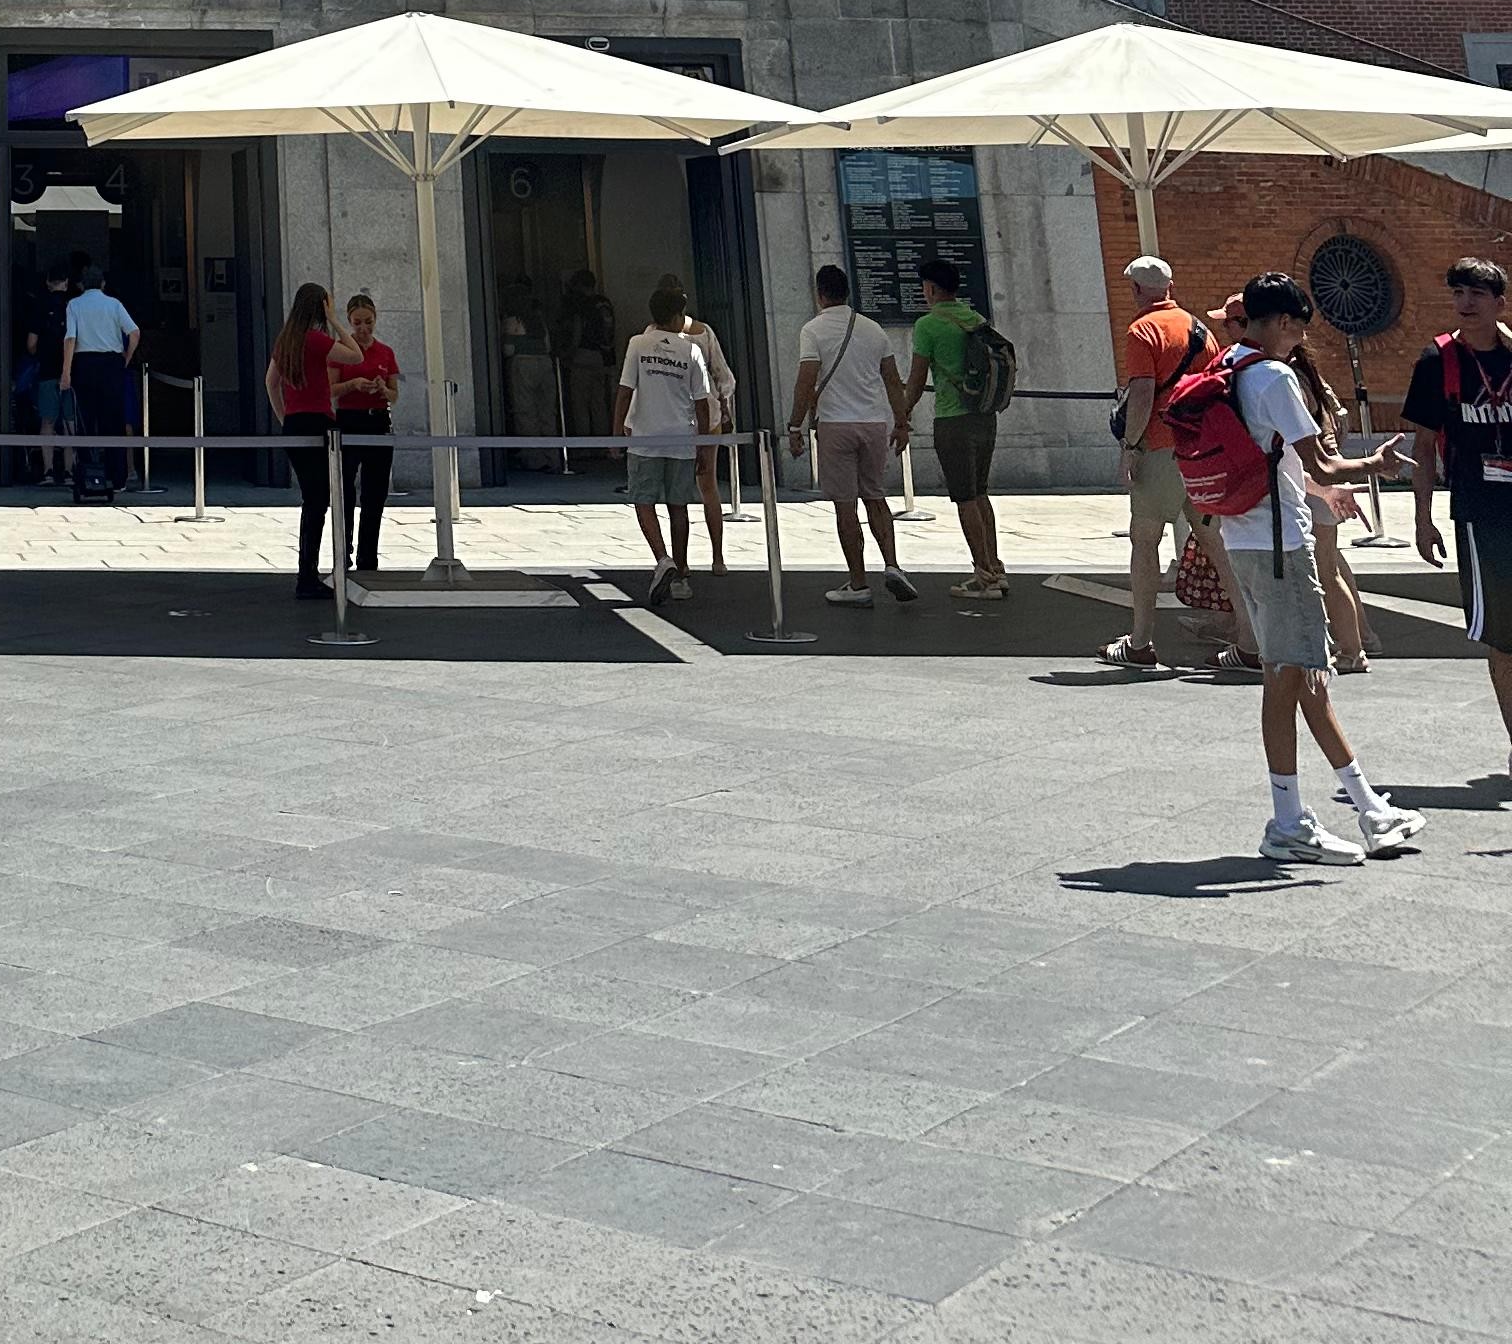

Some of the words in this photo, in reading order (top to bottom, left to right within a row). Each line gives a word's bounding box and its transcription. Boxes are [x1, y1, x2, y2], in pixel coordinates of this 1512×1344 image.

[14, 164, 35, 196] 3
[104, 164, 129, 195] 4
[510, 168, 532, 199] 6
